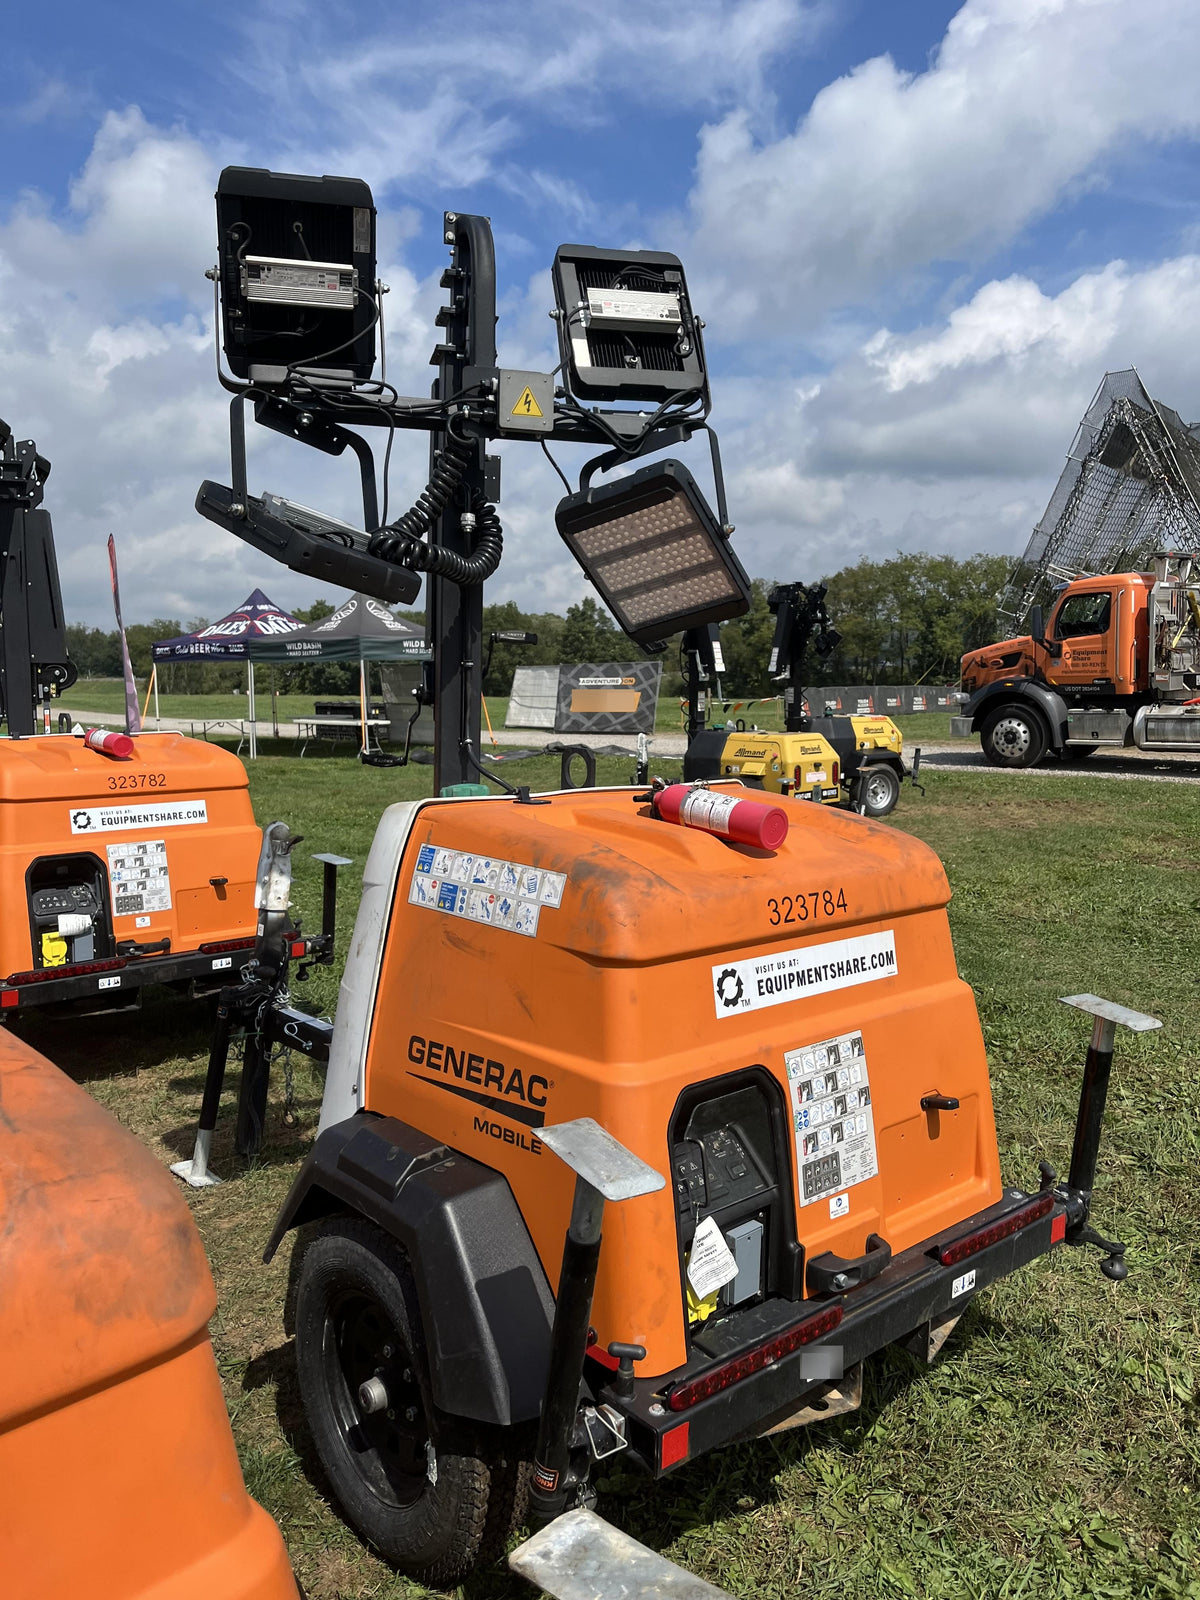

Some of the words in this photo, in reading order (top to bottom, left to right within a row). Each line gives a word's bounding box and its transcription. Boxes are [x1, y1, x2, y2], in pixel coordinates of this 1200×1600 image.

[190, 644, 210, 654] BEER
[403, 640, 415, 648] WILD
[734, 748, 767, 758] Allmand
[800, 745, 822, 755] Allmand
[107, 774, 167, 790] 323782
[101, 809, 205, 826] EQUIPMENTSHARE.COM
[767, 887, 848, 926] 323784
[755, 964, 774, 975] VISIT
[777, 960, 786, 970] US
[788, 958, 800, 968] AT:
[757, 950, 895, 997] EQUIPMENTSHARE.COM
[741, 998, 751, 1008] TM
[473, 1116, 542, 1155] MOBILE
